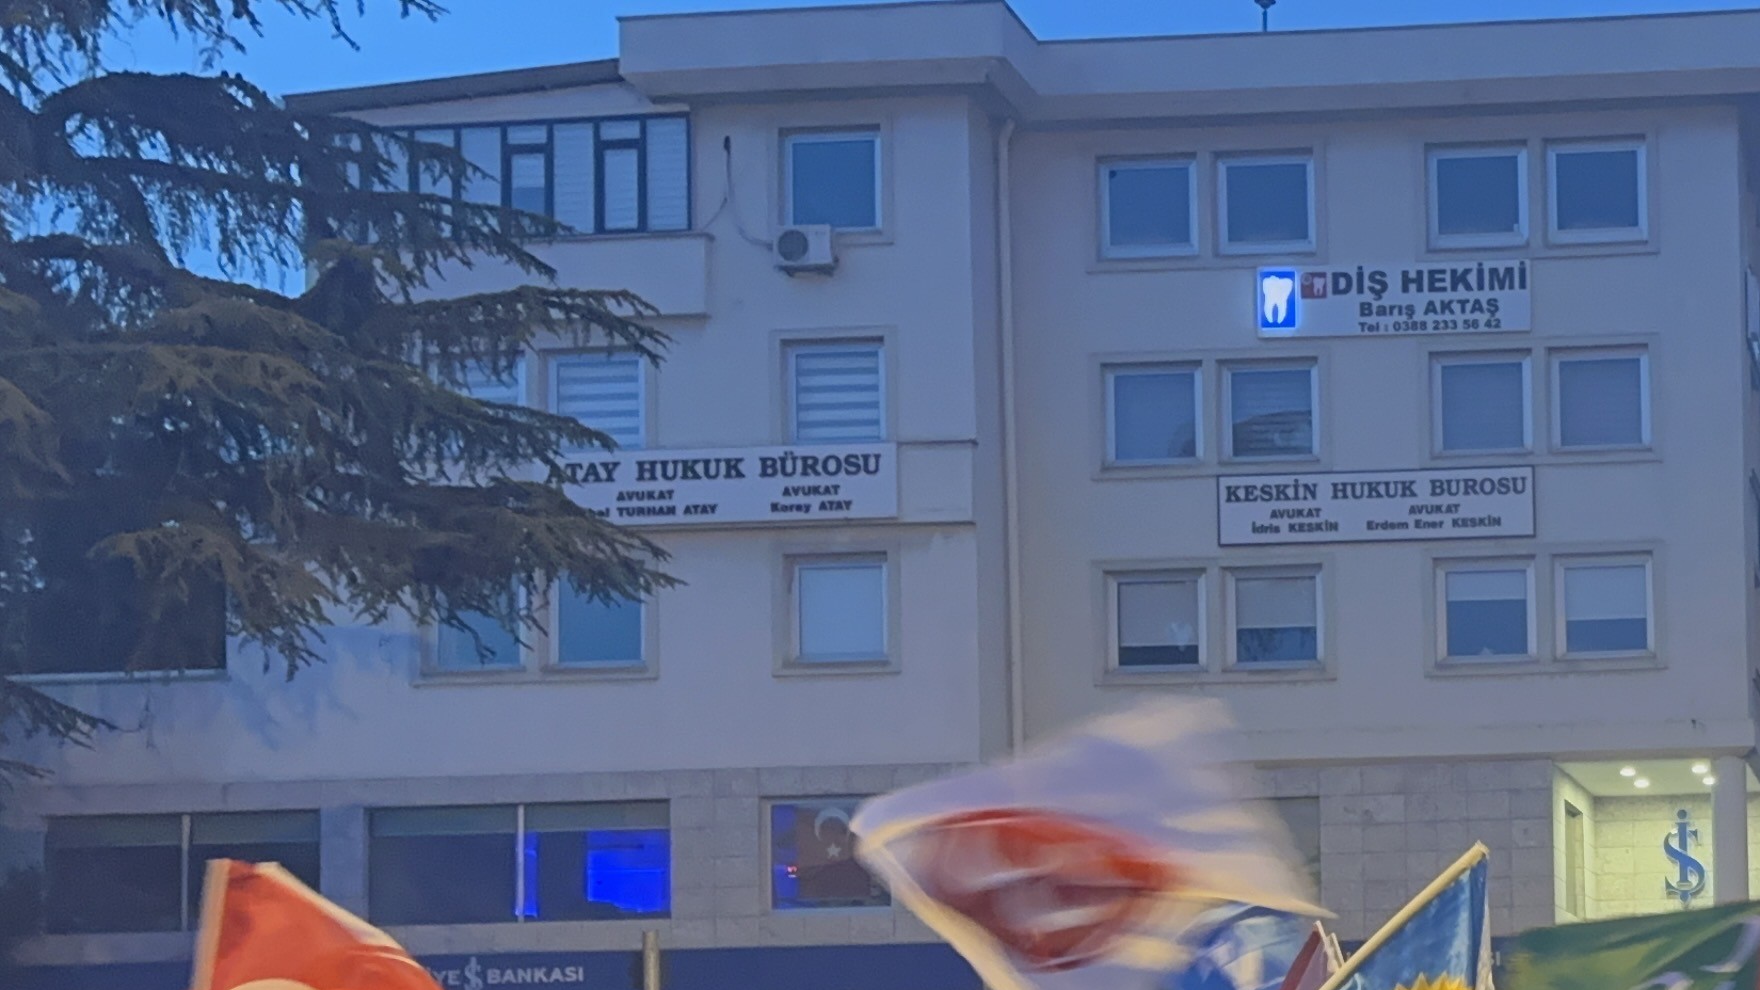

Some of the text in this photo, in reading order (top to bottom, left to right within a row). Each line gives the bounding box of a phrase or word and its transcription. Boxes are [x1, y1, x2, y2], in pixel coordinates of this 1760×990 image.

[1331, 261, 1527, 300] DİŞ HEKİMİ
[1359, 298, 1500, 320] Barış AKTAŞ
[1358, 321, 1381, 333] Tel
[635, 457, 746, 482] HUKUK
[759, 451, 881, 478] BÜROSU
[616, 490, 675, 502] AVUKAT
[782, 484, 840, 496] AVUKAT
[1225, 478, 1318, 503] KESKİN
[1331, 480, 1418, 500] HUKUK
[683, 504, 719, 516] ATAY
[818, 500, 853, 511] ATAY
[1408, 503, 1461, 515] AVUKAT
[1270, 507, 1322, 519] AVUKAT
[1288, 519, 1339, 533] KESKİN
[1366, 515, 1502, 531] Erdem Ener KESKİN
[486, 966, 585, 985] BANKASI
